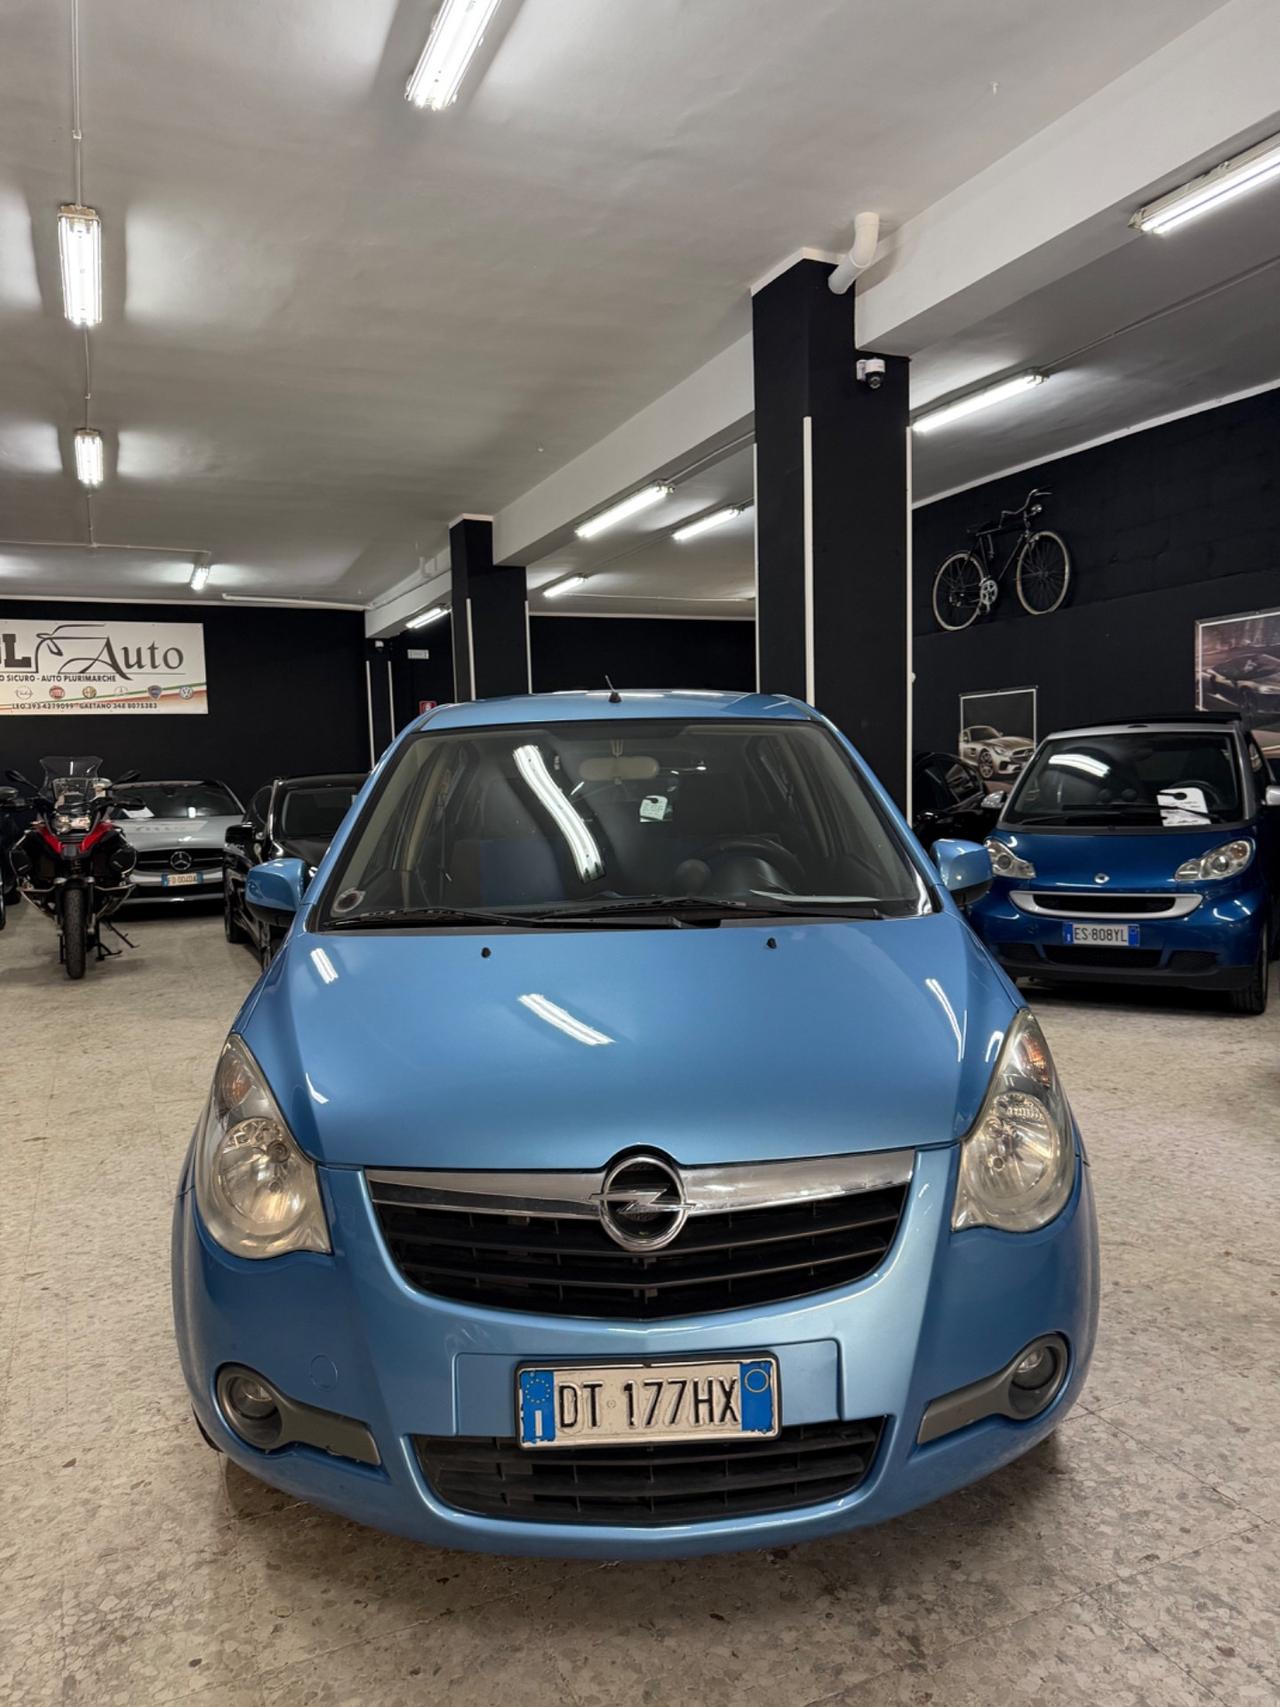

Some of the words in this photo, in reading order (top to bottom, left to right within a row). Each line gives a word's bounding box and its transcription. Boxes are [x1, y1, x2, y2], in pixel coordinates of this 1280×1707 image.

[0, 633, 32, 668] L
[77, 636, 185, 681] Auto
[6, 674, 36, 683] SICURO
[41, 674, 62, 683] AUTO
[63, 674, 117, 683] PLURIMARCHE
[1074, 927, 1089, 941] ES
[1091, 928, 1128, 942] 808YL
[557, 1380, 604, 1429] DT
[623, 1375, 740, 1427] 177HX
